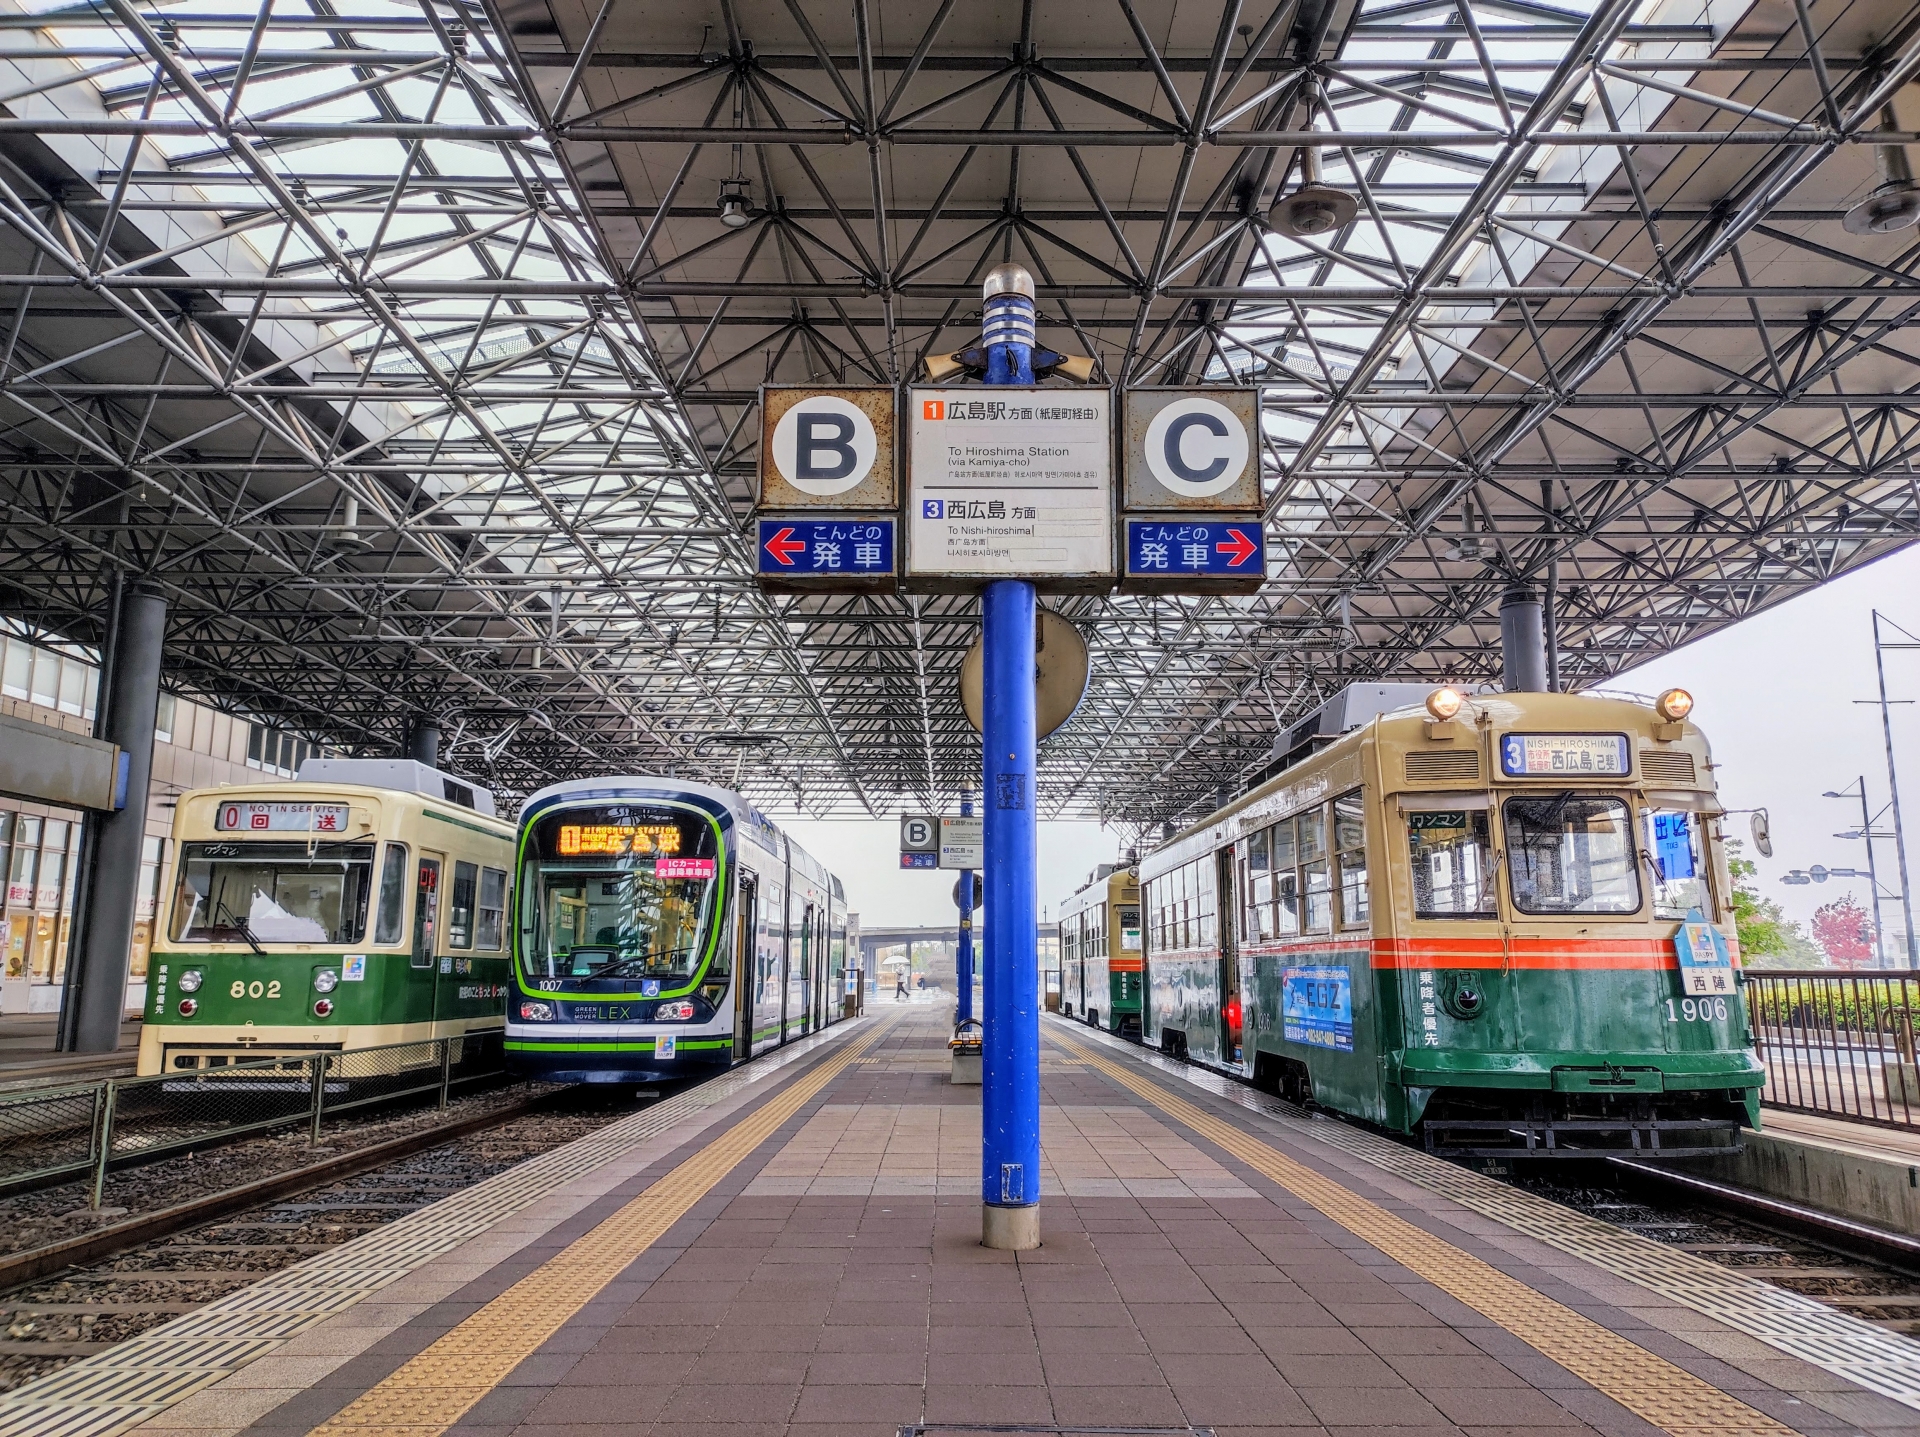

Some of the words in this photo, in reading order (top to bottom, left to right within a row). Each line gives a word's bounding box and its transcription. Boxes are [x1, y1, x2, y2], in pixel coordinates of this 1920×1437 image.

[796, 412, 858, 480] B
[948, 447, 962, 456] To
[966, 446, 1025, 456] Hiroshima
[1029, 446, 1070, 456] Station
[1163, 412, 1230, 483] C
[948, 457, 966, 467] (via
[968, 457, 1030, 467] Kamiya-cho)
[947, 500, 1006, 520] 西広島
[1011, 506, 1037, 519] 方面
[813, 525, 882, 541] こんどの
[947, 526, 958, 535] To
[961, 525, 1031, 535] Nishi-hiroshima
[1140, 526, 1209, 542] こんどの
[1527, 740, 1617, 749] NISHI-HIROSHIMA
[1507, 742, 1522, 769] 3
[291, 805, 342, 813] SERVICE
[226, 807, 239, 828] 0
[1412, 814, 1463, 828] ワンマン
[583, 826, 635, 835] HIROSHIMA
[638, 826, 678, 835] STATION
[909, 823, 927, 843] B
[668, 860, 702, 868] ICカード
[1695, 951, 1714, 959] PASPY
[230, 980, 281, 999] 802
[538, 980, 563, 992] 1007
[1692, 975, 1726, 992] 西陣
[1306, 982, 1341, 1010] EGZ
[598, 1006, 631, 1020] LEX
[1419, 971, 1439, 1046] 乗降者優先
[1665, 997, 1728, 1022] 1906
